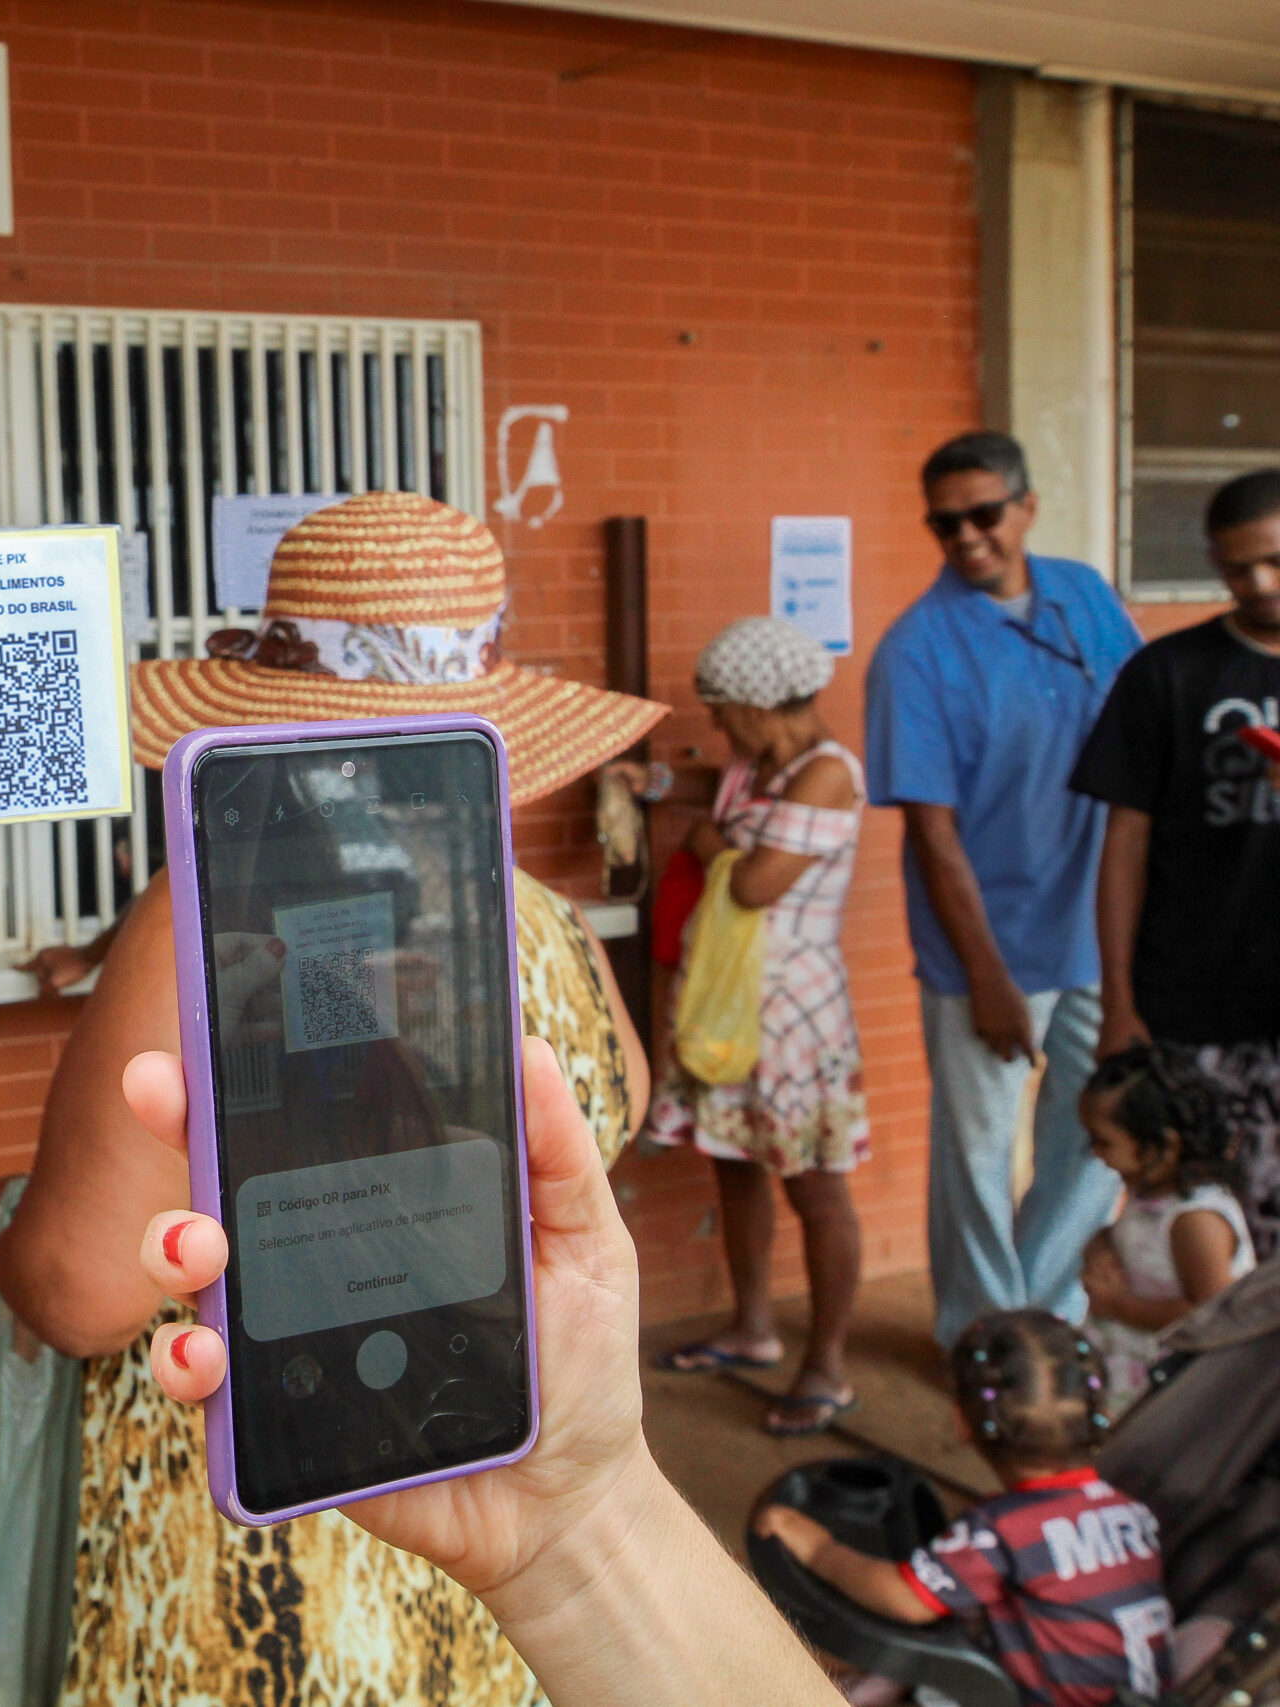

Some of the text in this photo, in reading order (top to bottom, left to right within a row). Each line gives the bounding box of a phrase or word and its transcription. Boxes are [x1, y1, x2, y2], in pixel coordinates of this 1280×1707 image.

[7, 553, 27, 565] PIX
[8, 603, 27, 615] DO
[30, 600, 77, 614] BRASIL
[322, 1192, 340, 1206] QR
[342, 1188, 368, 1204] para
[370, 1183, 391, 1197] PIX
[258, 1231, 315, 1251] Selecione
[317, 1227, 336, 1241] um
[339, 1218, 393, 1239] aplicativo
[395, 1214, 409, 1226] de
[347, 1272, 409, 1293] Continuar
